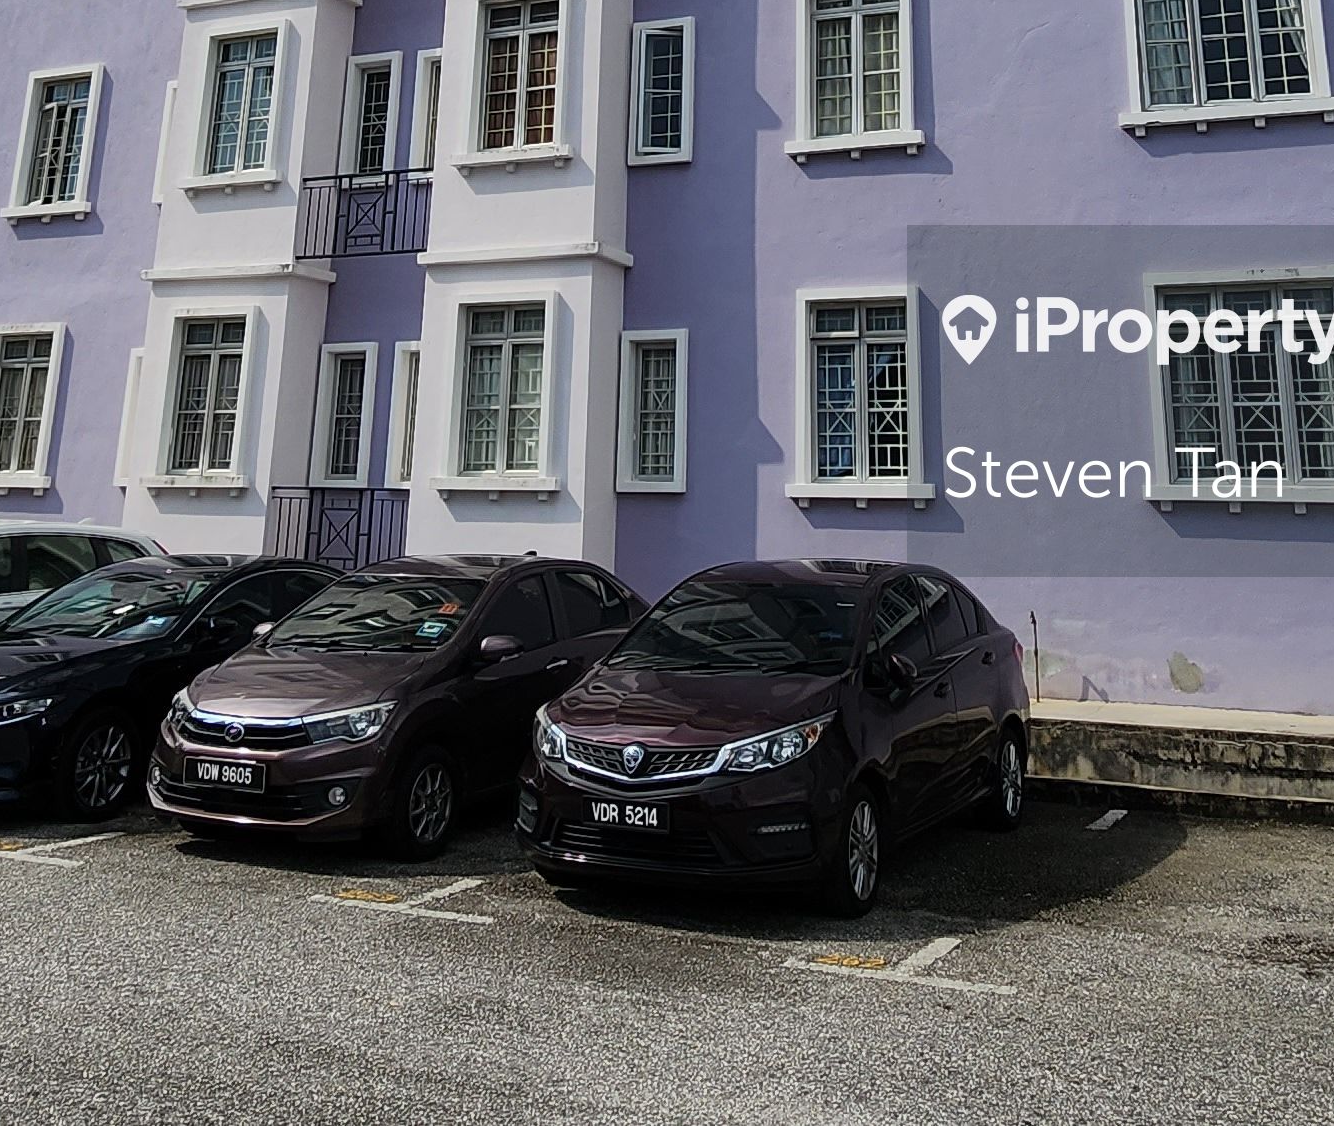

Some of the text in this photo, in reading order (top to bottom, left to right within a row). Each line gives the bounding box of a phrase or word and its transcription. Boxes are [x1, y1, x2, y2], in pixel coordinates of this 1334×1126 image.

[197, 762, 253, 785] VDW 9605
[591, 801, 658, 827] VDR 5214
